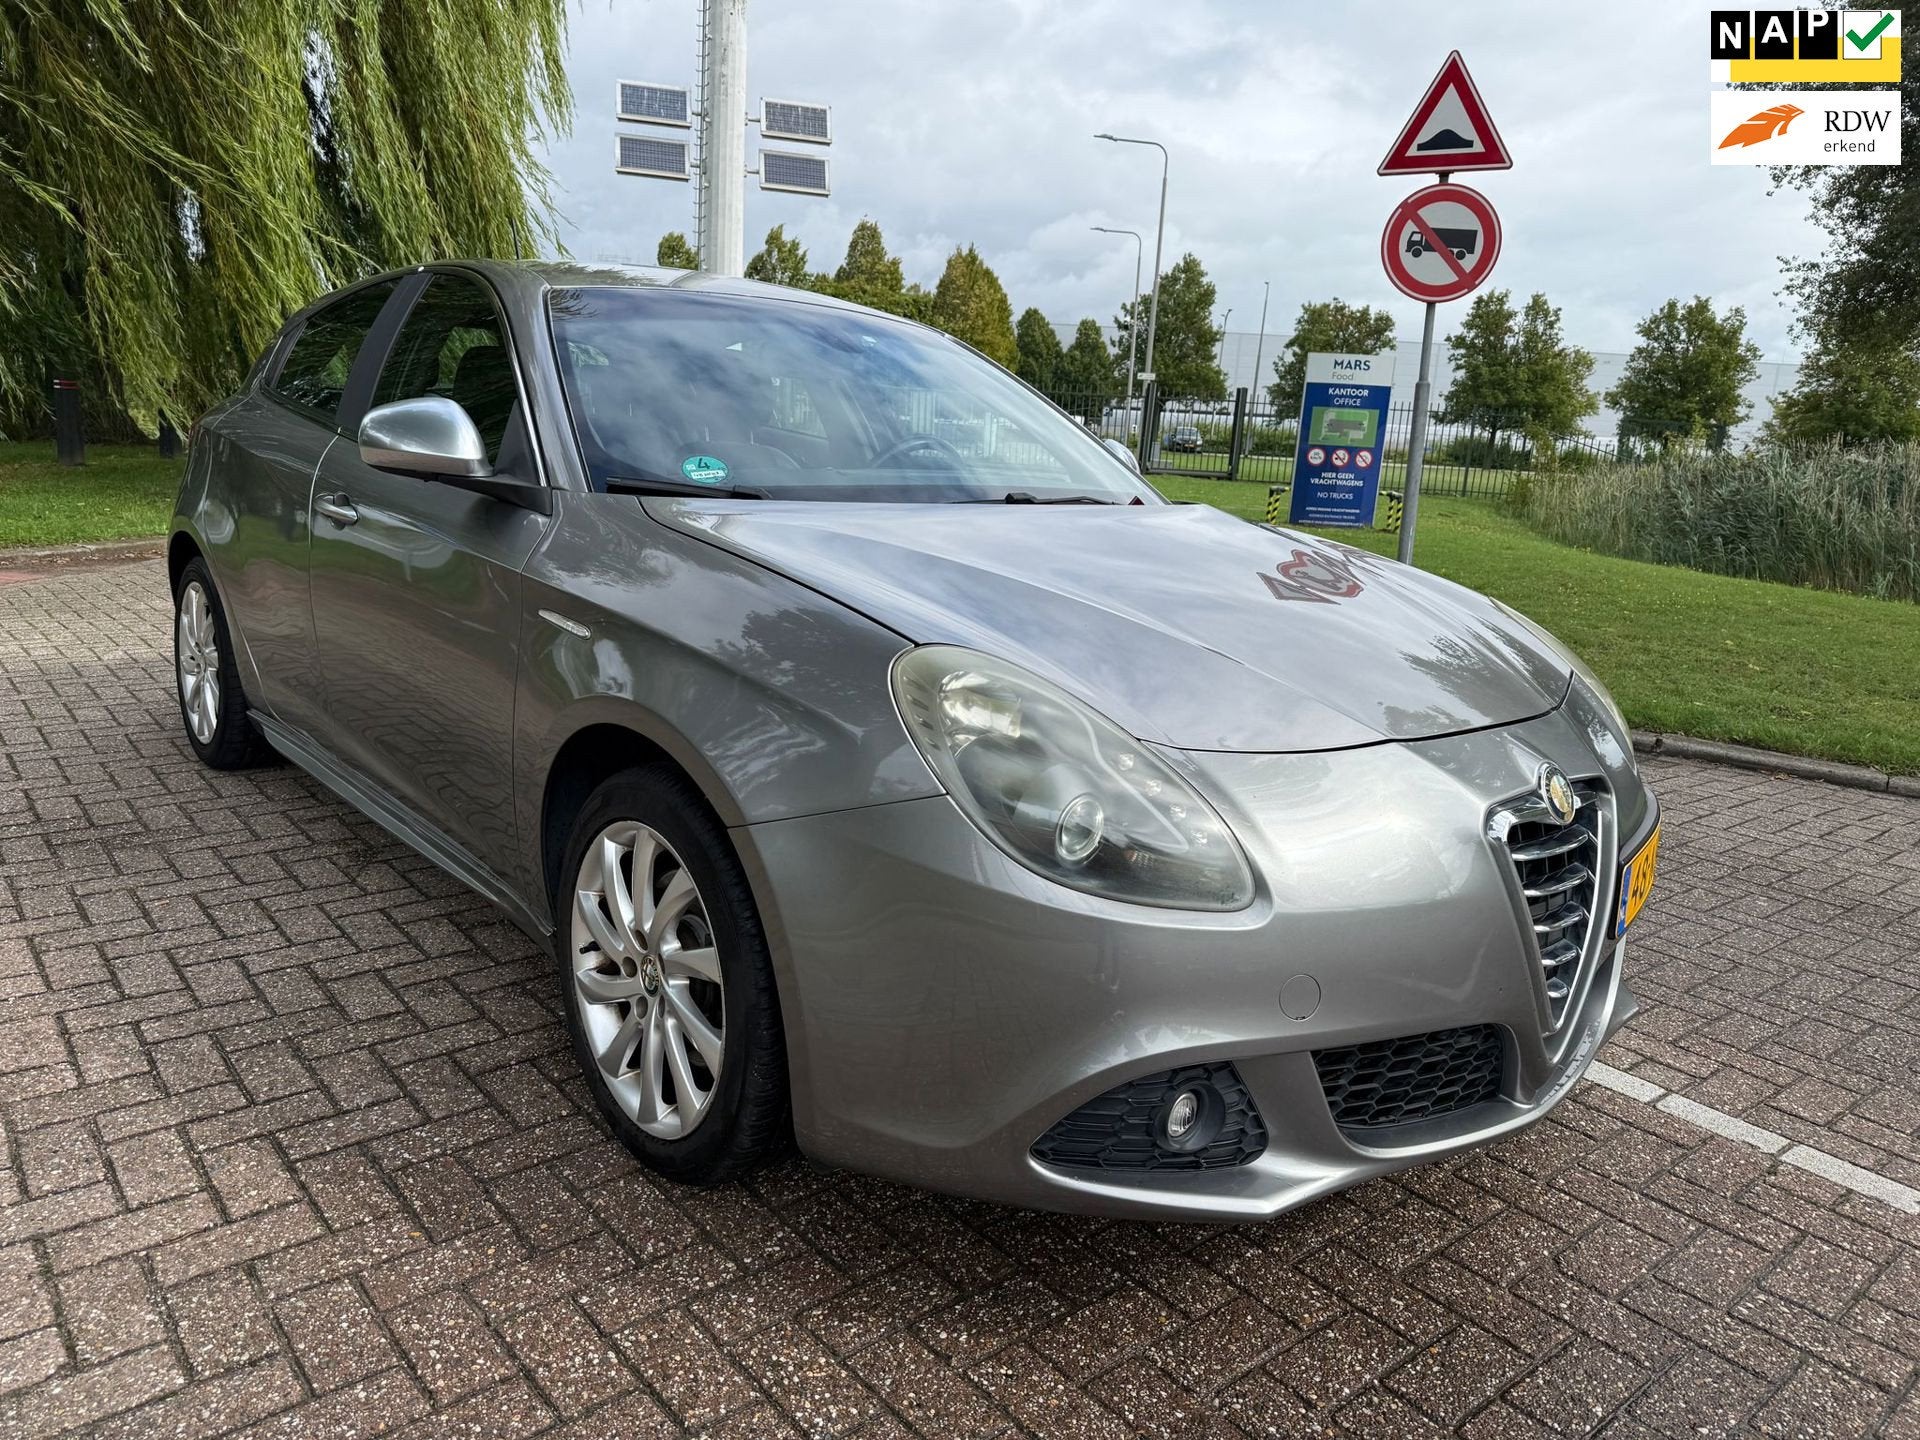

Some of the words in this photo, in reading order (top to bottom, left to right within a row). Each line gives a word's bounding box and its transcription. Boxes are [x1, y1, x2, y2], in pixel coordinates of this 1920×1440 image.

[1333, 358, 1371, 371] MARS
[1332, 371, 1354, 381] Food
[1328, 387, 1369, 397] KANTOOR
[1333, 397, 1361, 406] OFFICE
[698, 457, 710, 469] 4
[1337, 472, 1355, 480] GEEN
[1310, 478, 1364, 487] VRACHTWAGENS
[1329, 492, 1354, 500] TRUCKS
